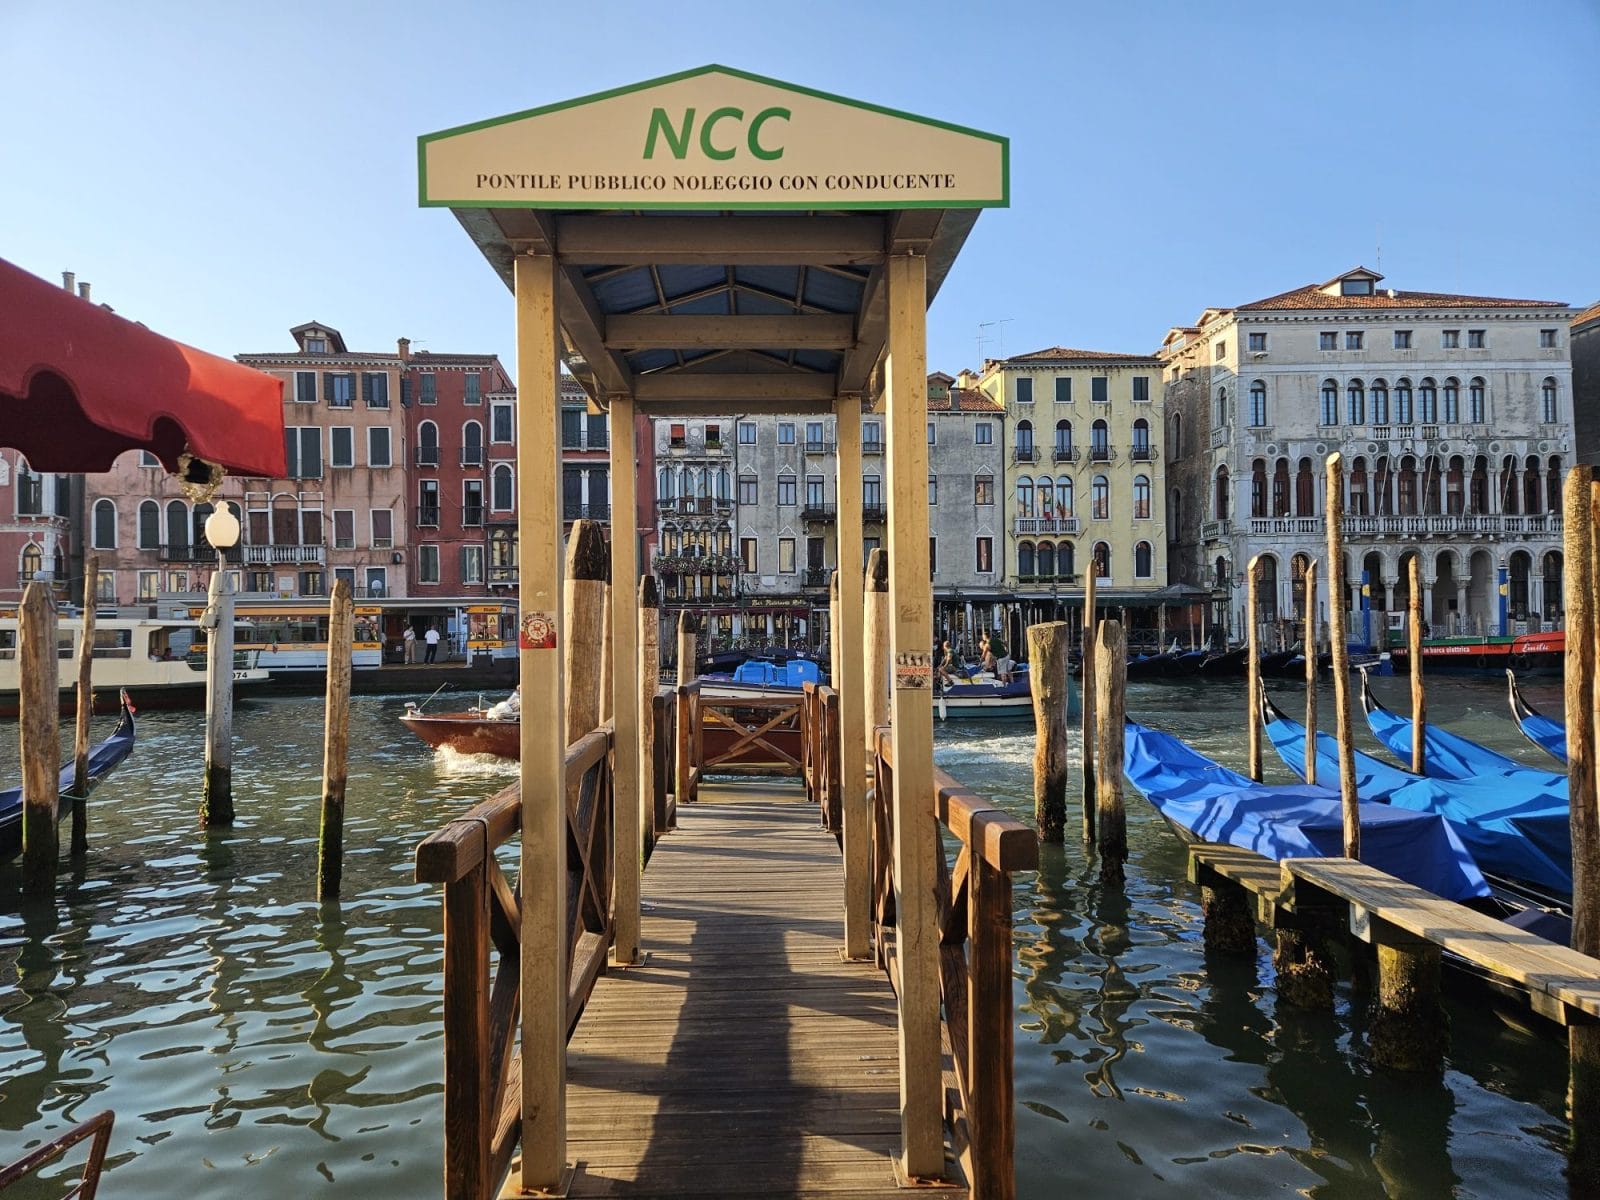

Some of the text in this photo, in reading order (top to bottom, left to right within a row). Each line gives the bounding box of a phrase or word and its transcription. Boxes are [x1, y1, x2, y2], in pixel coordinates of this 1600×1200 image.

[642, 107, 792, 161] NCC
[476, 173, 956, 190] PONTILE PUBBLICO NOLEGGIO CON CONDUCENTE
